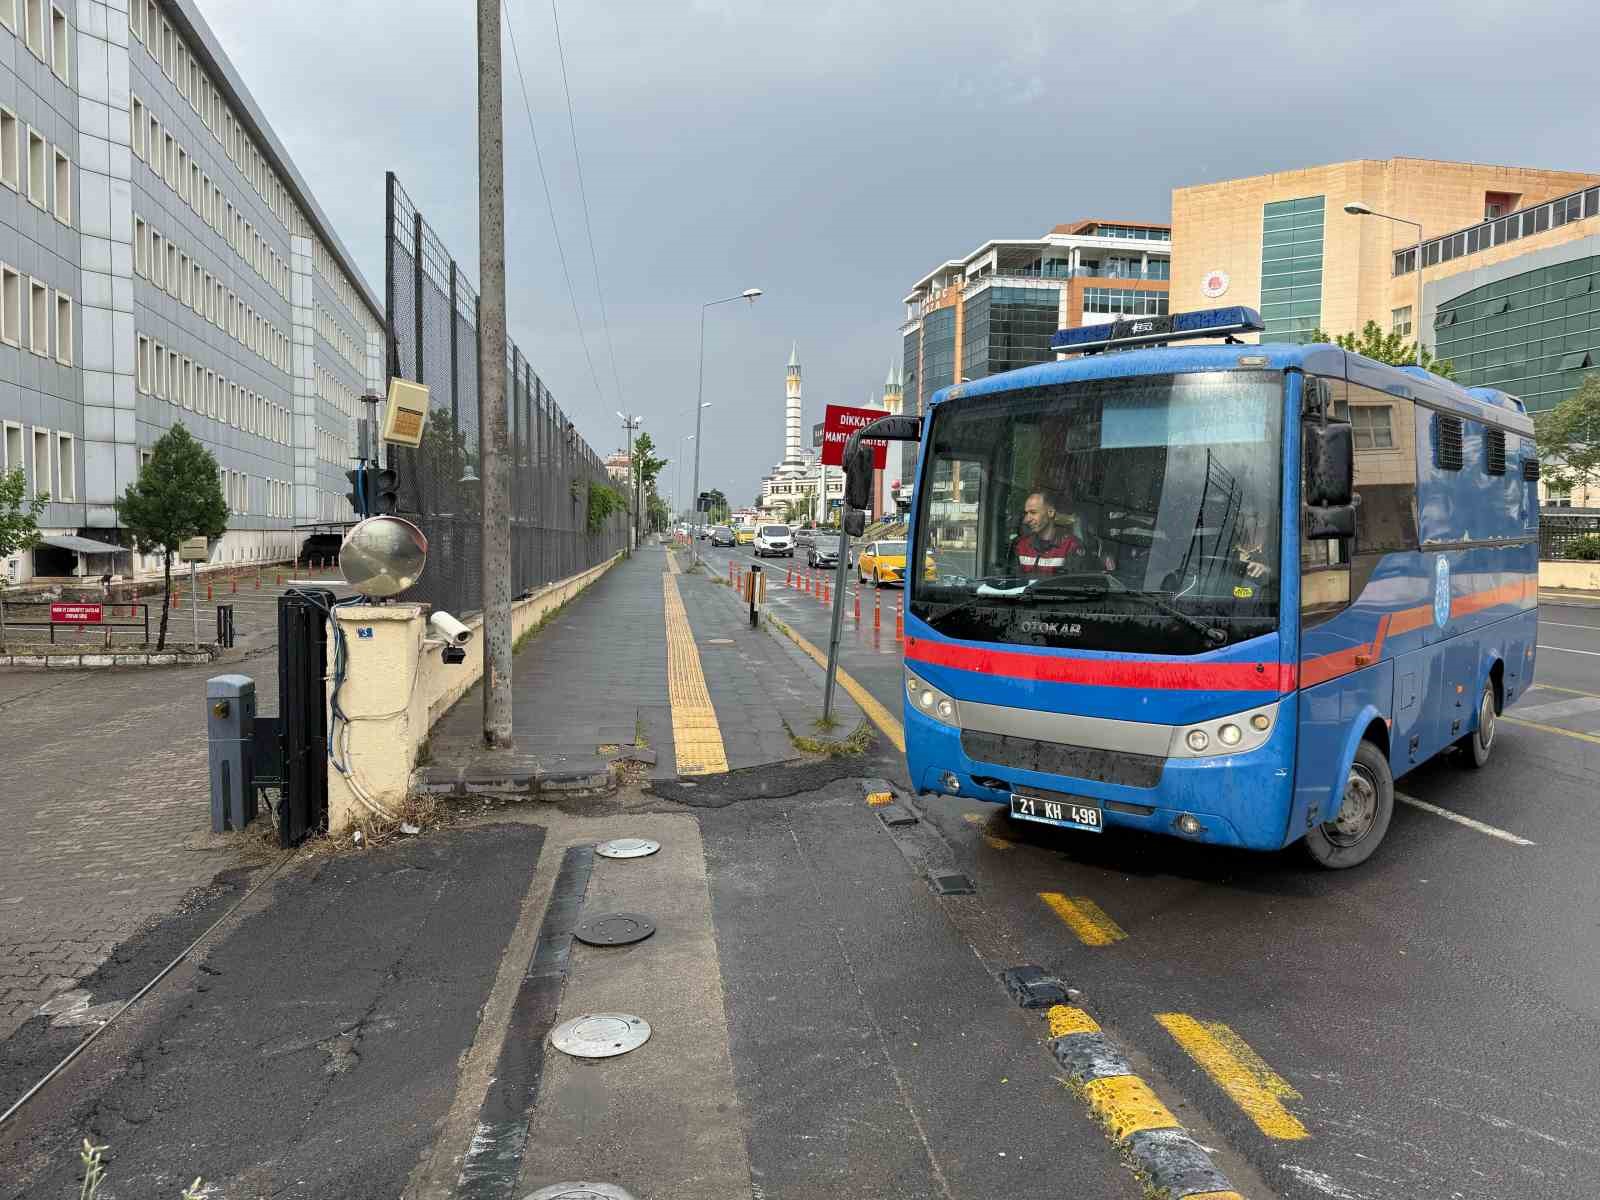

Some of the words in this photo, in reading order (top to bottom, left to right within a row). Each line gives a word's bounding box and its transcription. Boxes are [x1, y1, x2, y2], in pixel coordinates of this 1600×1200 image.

[840, 412, 871, 427] DİKKAT
[1022, 621, 1081, 634] OTOKAR
[1020, 798, 1035, 815] 21
[1044, 802, 1062, 819] KH
[1071, 807, 1097, 826] 498
